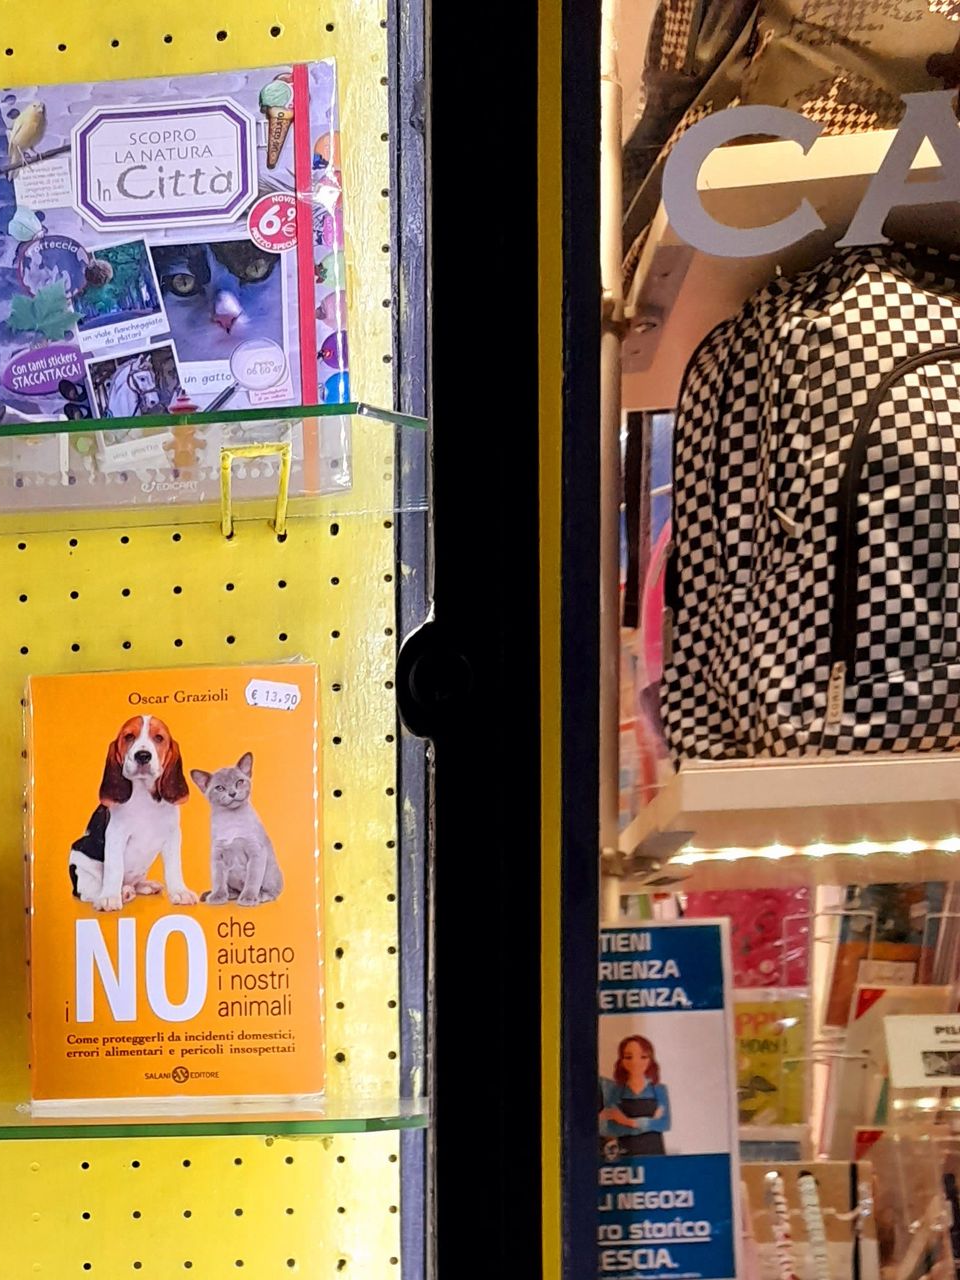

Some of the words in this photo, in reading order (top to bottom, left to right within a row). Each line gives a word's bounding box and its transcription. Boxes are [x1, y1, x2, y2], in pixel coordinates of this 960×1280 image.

[129, 129, 196, 145] SCOPRO
[115, 150, 136, 164] LA
[141, 145, 213, 162] NATURA
[97, 178, 112, 201] In
[117, 165, 233, 200] Città
[12, 364, 27, 376] Con
[28, 358, 47, 372] tanti
[48, 352, 78, 368] stickers
[12, 363, 82, 390] STACCATTACCA!
[184, 375, 197, 384] un
[202, 372, 232, 385] gatto
[128, 692, 169, 705] Oscar
[173, 689, 228, 704] Grazioli
[251, 689, 258, 700] €
[217, 917, 256, 938] che
[599, 932, 652, 953] TIENI
[217, 943, 295, 964] aiutano
[65, 1001, 70, 1023] i
[75, 914, 209, 1023] NO
[218, 969, 223, 990] i
[231, 968, 289, 990] nostri
[599, 959, 681, 981] RIENZA
[218, 994, 292, 1018] animali
[66, 1034, 100, 1046] Come
[102, 1031, 165, 1046] proteggerli
[167, 1032, 182, 1043] da
[184, 1030, 234, 1042] incidenti
[237, 1029, 296, 1041] domestici,
[66, 1047, 100, 1058] errori
[104, 1045, 163, 1057] alimentari
[168, 1048, 175, 1056] e
[180, 1044, 224, 1058] pericoli
[229, 1043, 296, 1056] insospettati
[144, 1072, 171, 1080] SALANI
[190, 1070, 219, 1079] EDITORE
[617, 1189, 695, 1210] NEGOZI
[629, 1217, 712, 1239] storico
